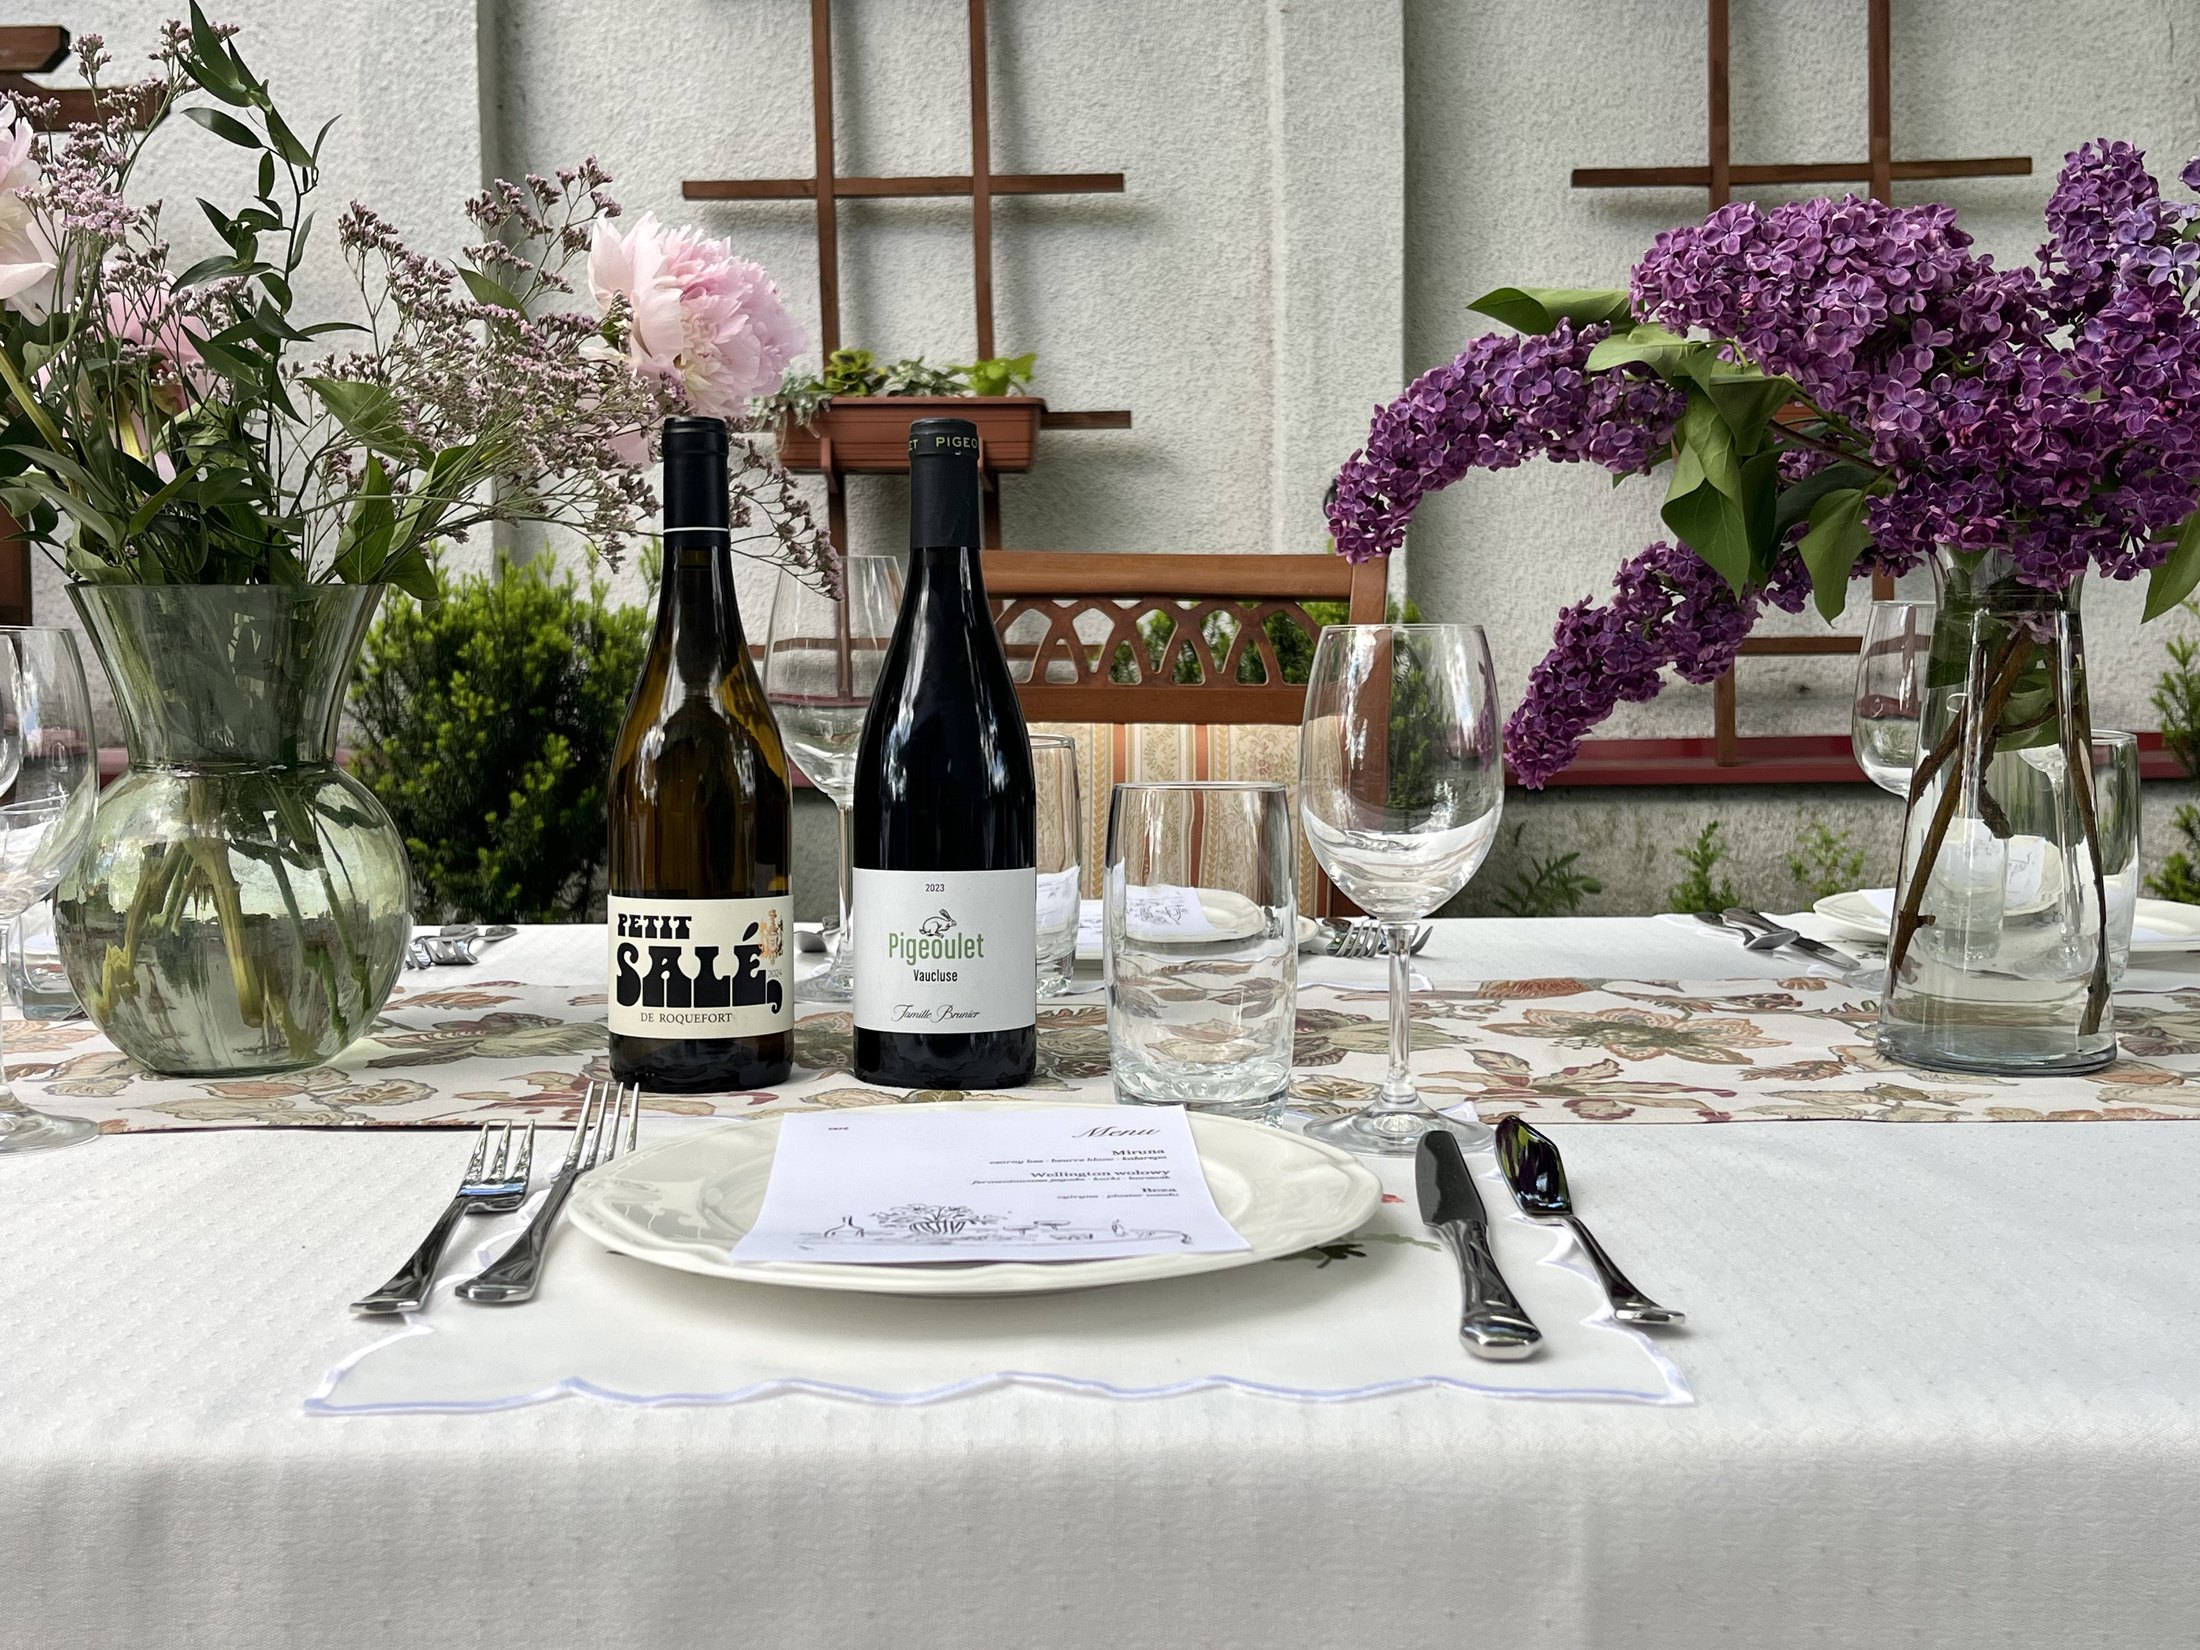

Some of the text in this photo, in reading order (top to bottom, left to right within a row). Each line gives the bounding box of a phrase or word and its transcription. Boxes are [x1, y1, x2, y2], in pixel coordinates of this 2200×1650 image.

[935, 436, 978, 449] PIGEO
[925, 883, 945, 892] 2023
[617, 913, 693, 940] PETIT
[888, 932, 985, 966] Pigeoulet
[913, 969, 958, 982] Vaucluse
[640, 1012, 733, 1025] DE ROQUEFORT
[1071, 1126, 1161, 1138] Menu
